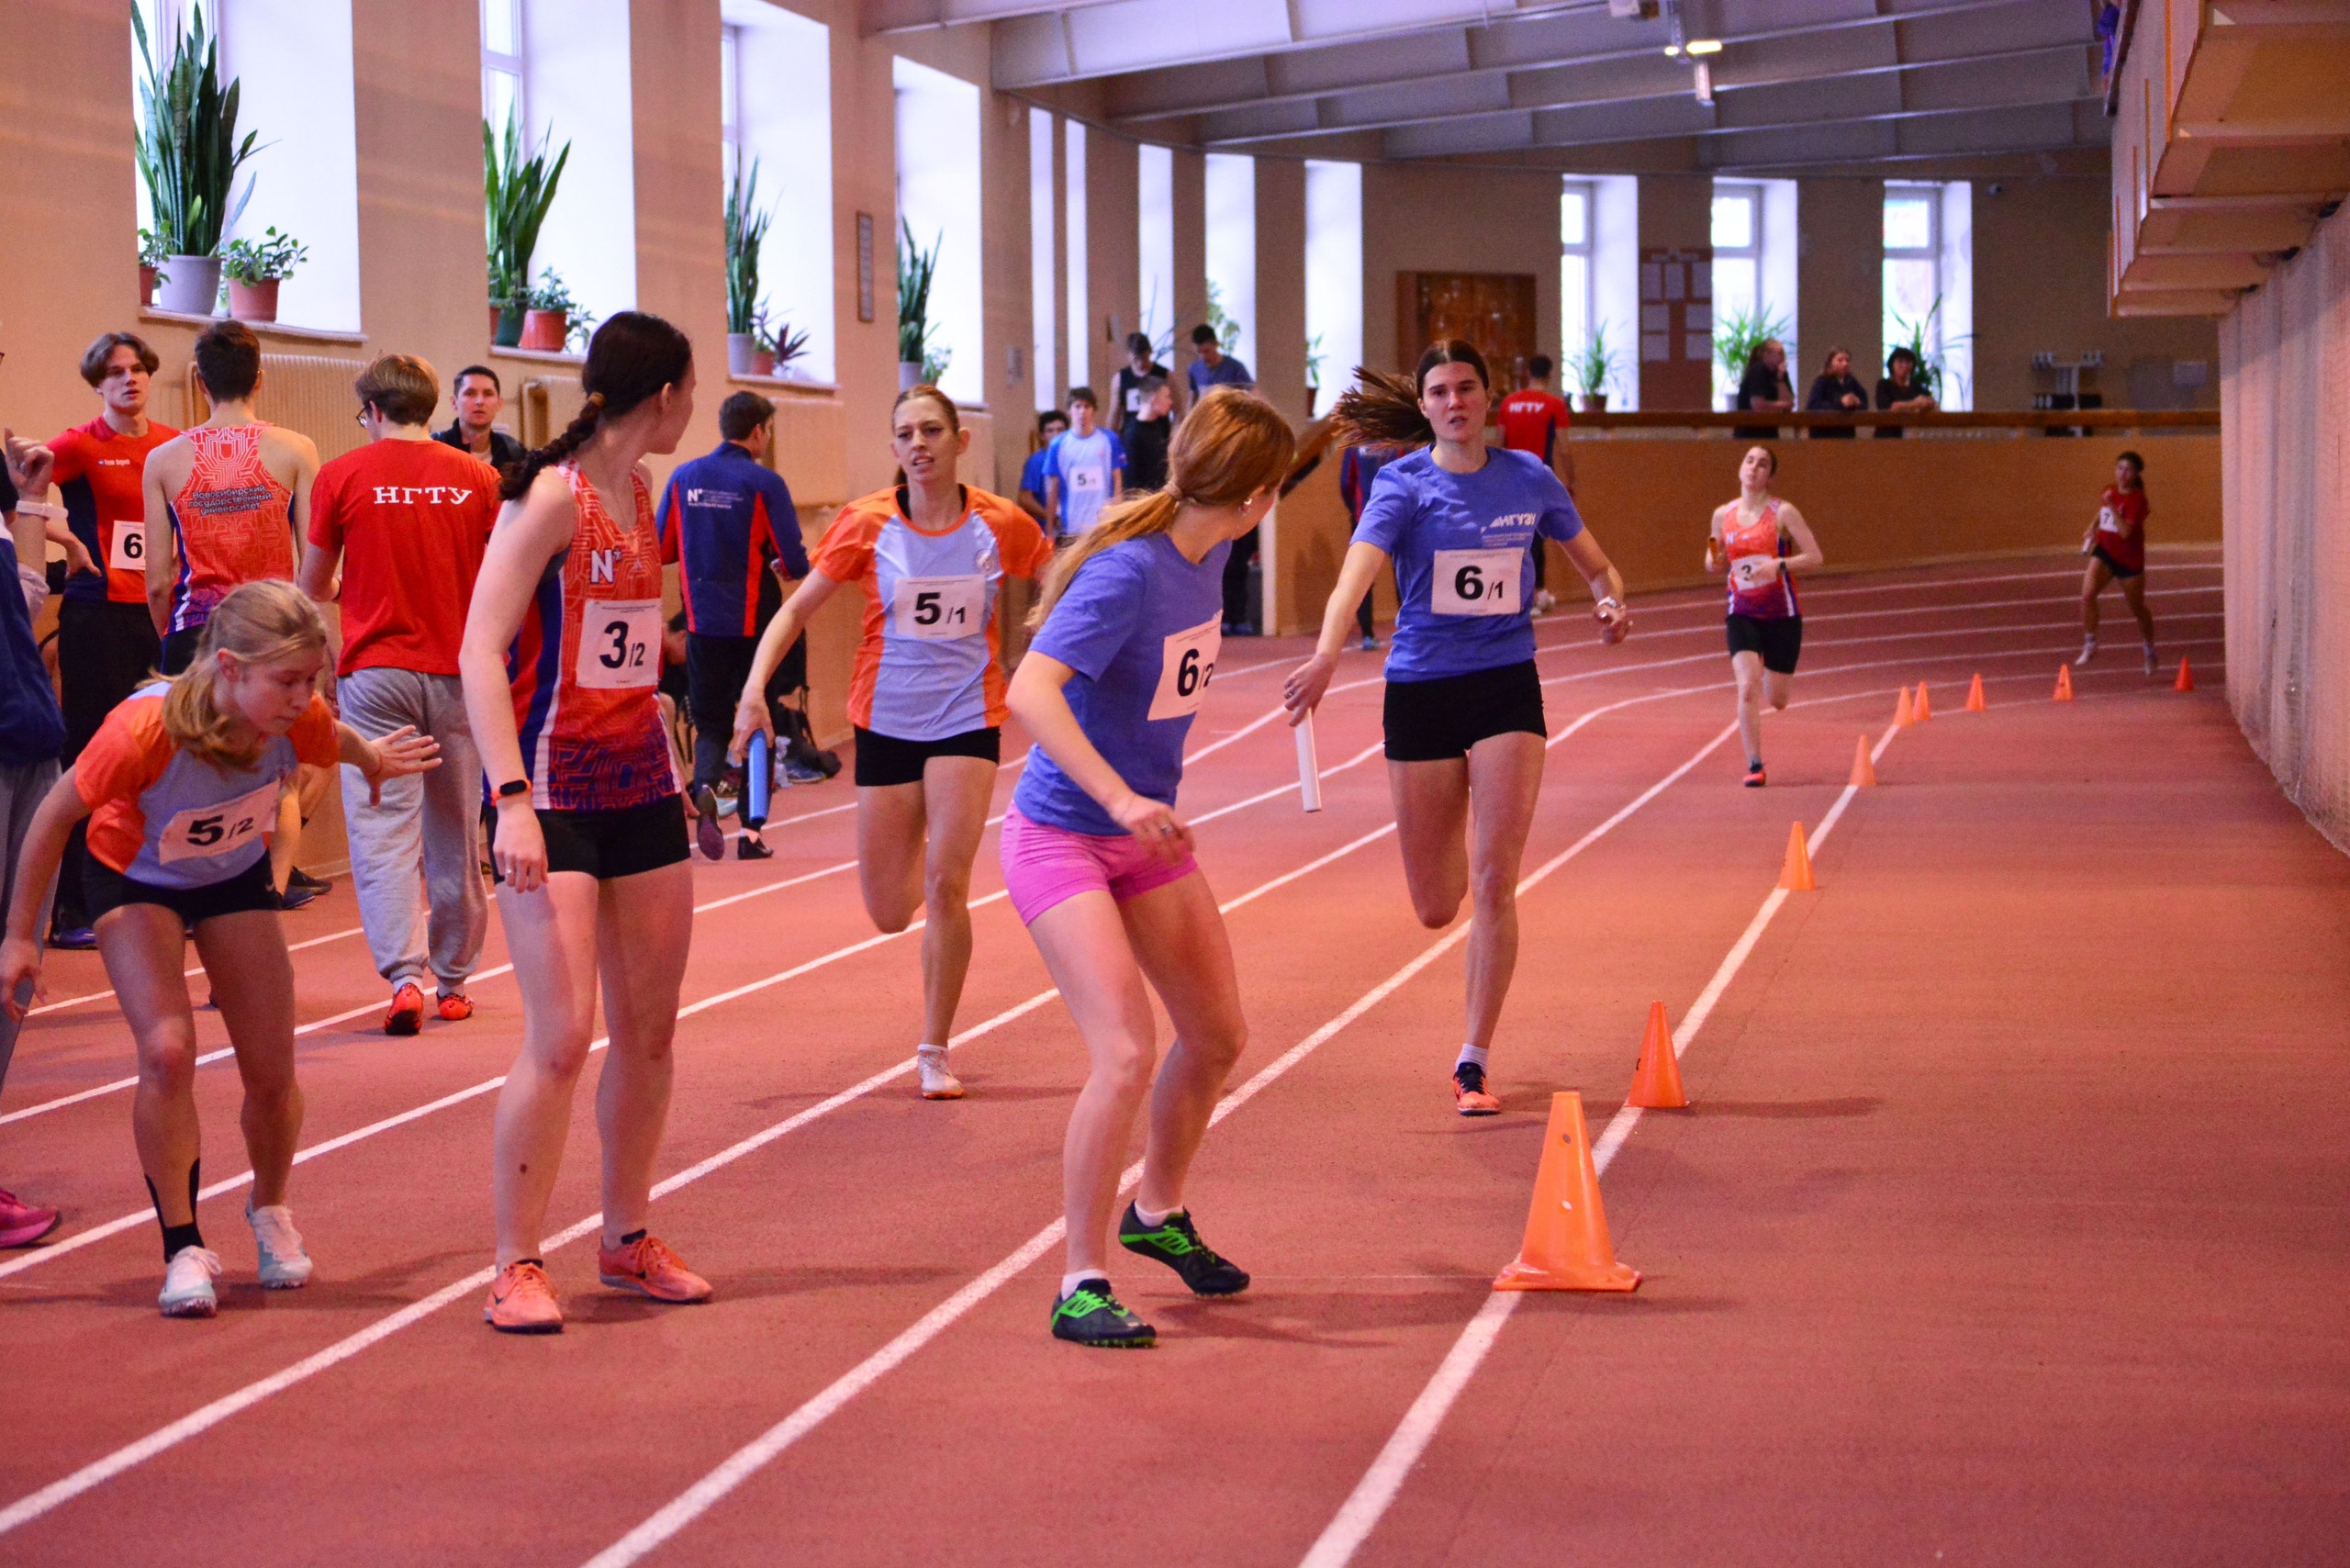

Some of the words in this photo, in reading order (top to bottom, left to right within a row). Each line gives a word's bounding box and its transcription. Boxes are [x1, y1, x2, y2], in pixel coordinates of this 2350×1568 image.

[188, 492, 272, 509] государственный
[193, 485, 266, 500] Новосибирский
[373, 487, 473, 505] НГТУ
[200, 502, 261, 516] университет
[124, 533, 143, 559] 6
[1455, 565, 1504, 600] 6/1
[914, 592, 966, 624] 5/1
[599, 621, 645, 668] 3/2
[186, 814, 254, 846] 5/2
